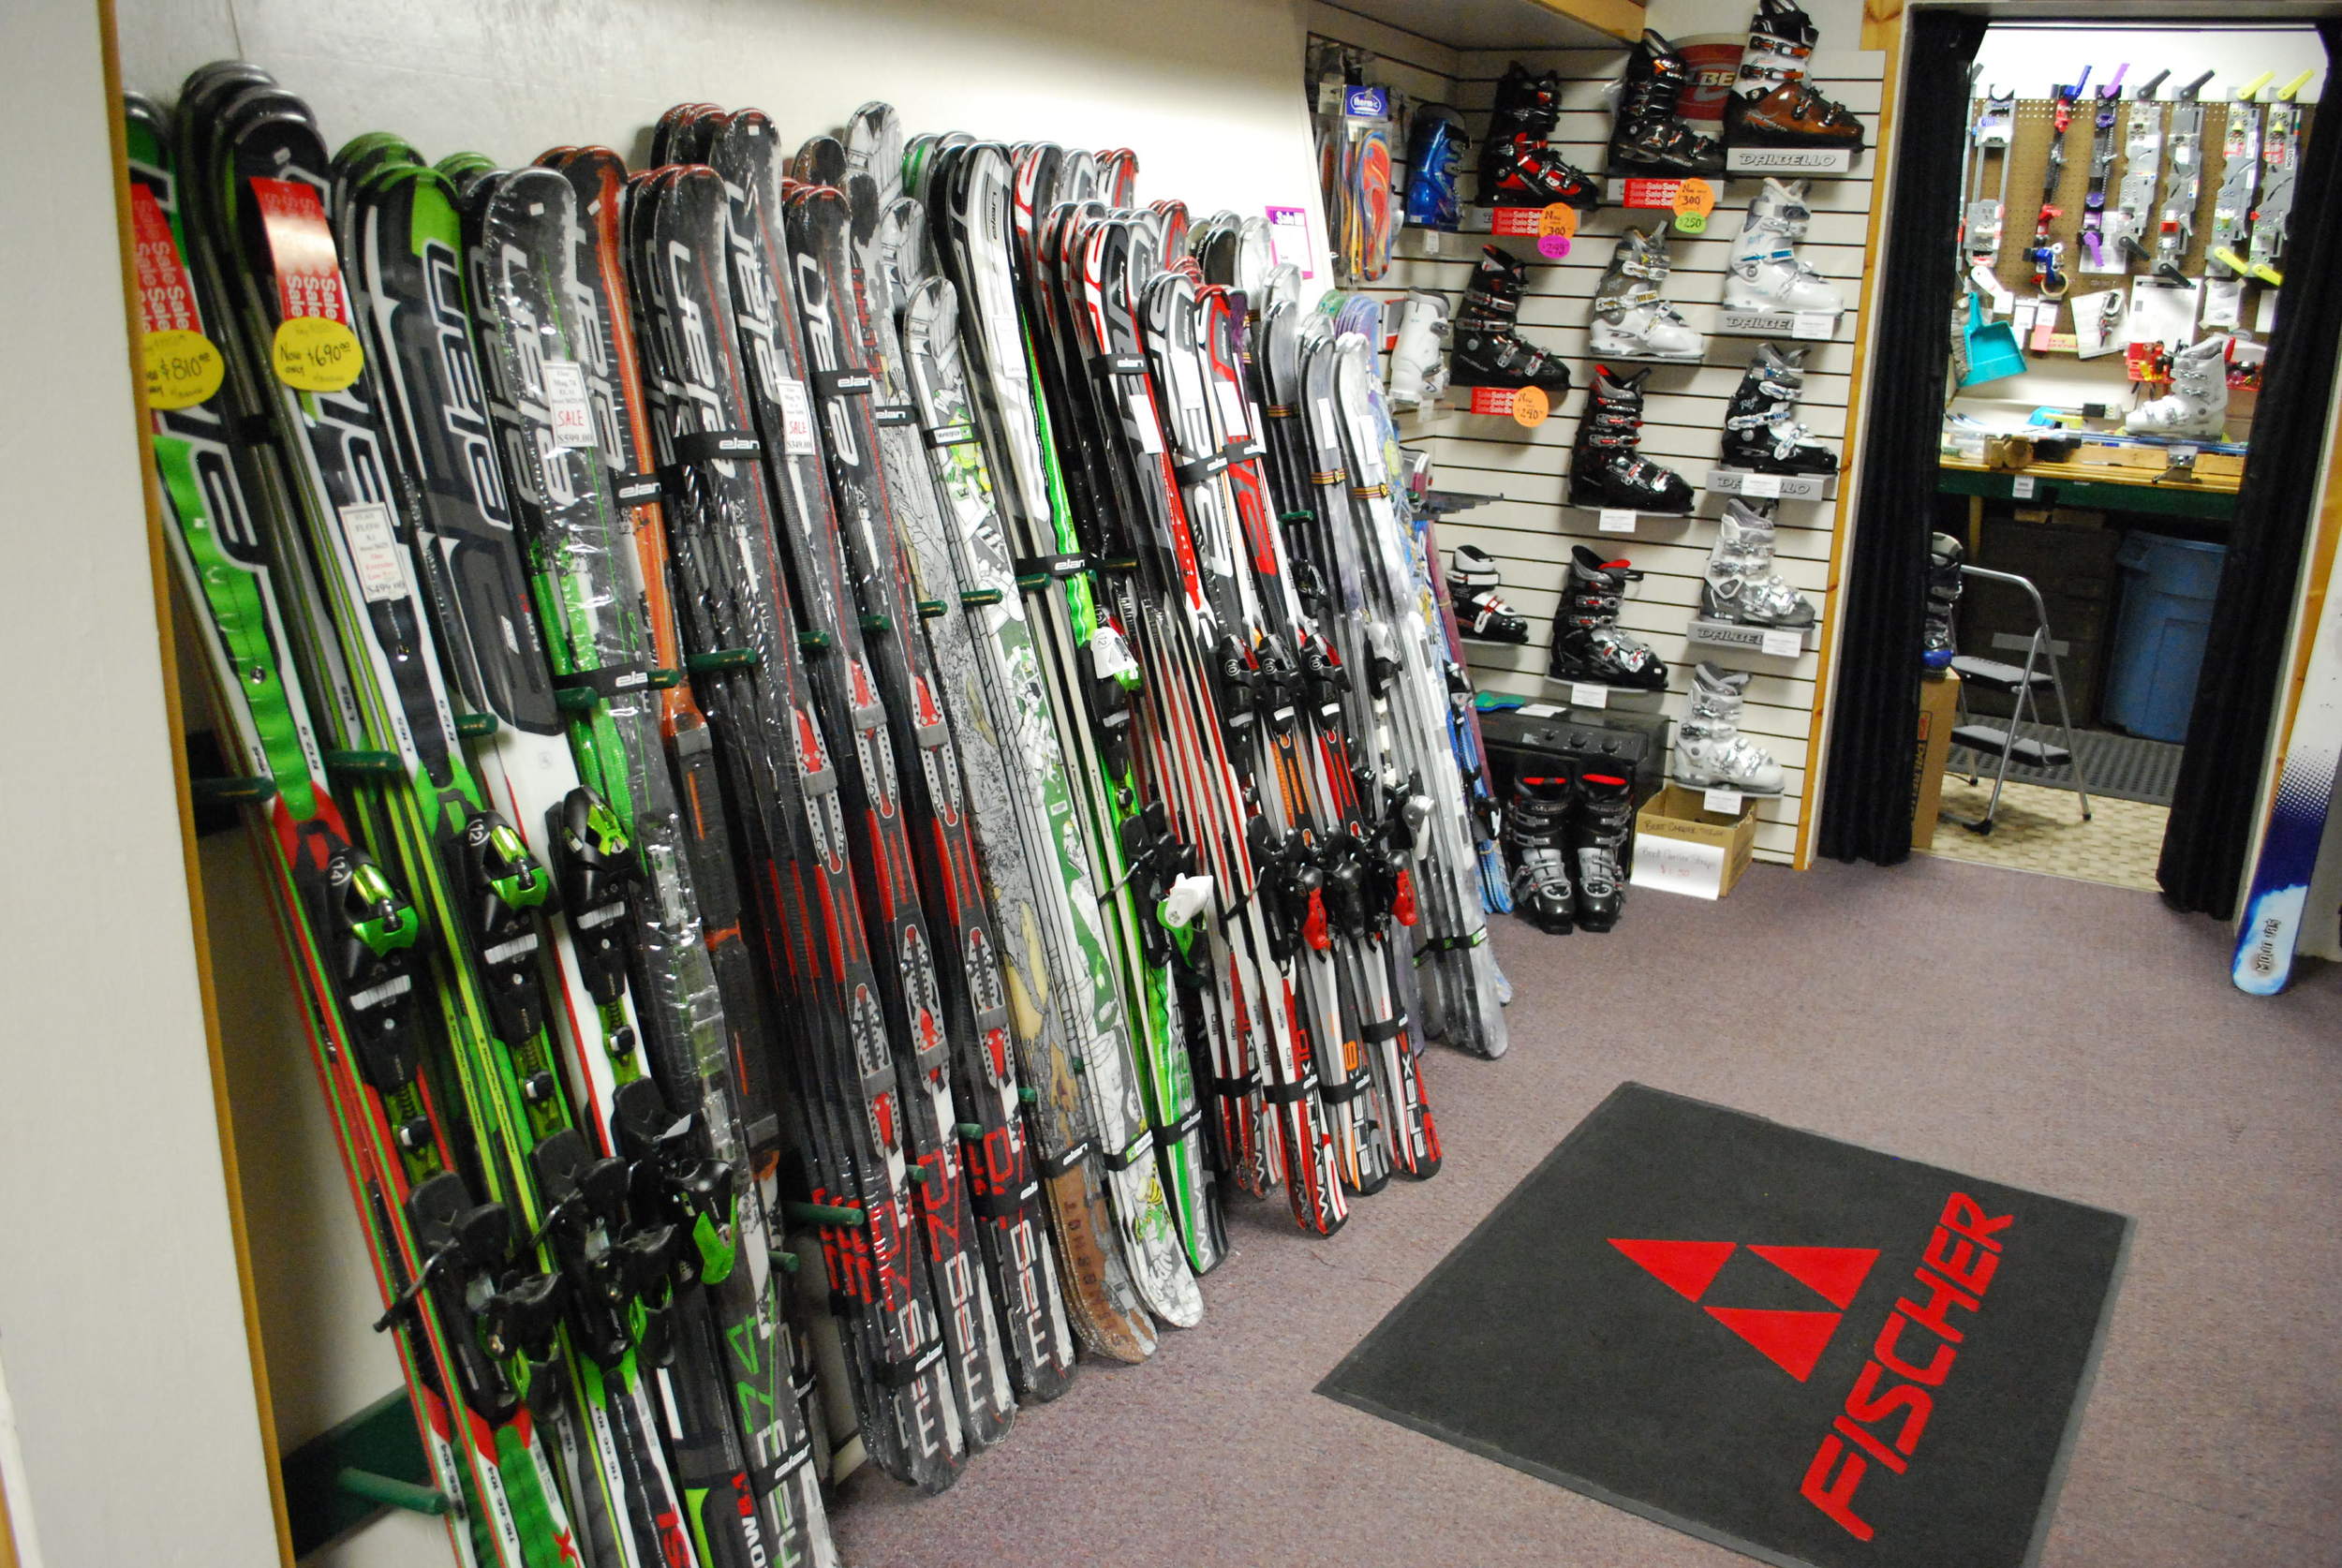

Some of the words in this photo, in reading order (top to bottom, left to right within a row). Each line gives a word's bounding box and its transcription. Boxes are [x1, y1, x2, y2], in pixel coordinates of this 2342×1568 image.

[1739, 153, 1837, 167] DALBELLO
[148, 287, 170, 331] Sale
[168, 285, 190, 330] Sale
[286, 275, 303, 318] Sale
[304, 275, 320, 318] Sale
[320, 277, 339, 320] Sale
[725, 181, 782, 404] elan
[1727, 317, 1794, 331] DALBEL
[501, 244, 576, 507] elan
[669, 240, 736, 480] elan
[796, 252, 860, 466] ean
[1117, 358, 1144, 367] elan
[422, 239, 512, 532] elan
[837, 376, 874, 388] elan
[557, 409, 585, 427] SALE
[789, 421, 808, 435] SALE
[875, 409, 906, 420] elan
[719, 436, 761, 451] elan
[618, 481, 662, 499] elan
[1717, 477, 1811, 496] DALLO
[1054, 558, 1086, 570] elan
[1697, 628, 1763, 645] DALBEL
[615, 671, 648, 688] ela
[468, 822, 484, 841] 12
[330, 861, 346, 880] 14
[1245, 1033, 1266, 1182] Waveex
[1401, 1055, 1426, 1158] eFlex
[1062, 1142, 1089, 1166] elan
[918, 1148, 959, 1263] 70
[1008, 1218, 1049, 1368] mag
[943, 1250, 987, 1413] mag
[915, 1340, 943, 1372] elan
[1800, 1191, 2015, 1542] FISCHER
[775, 1442, 811, 1479] elan
